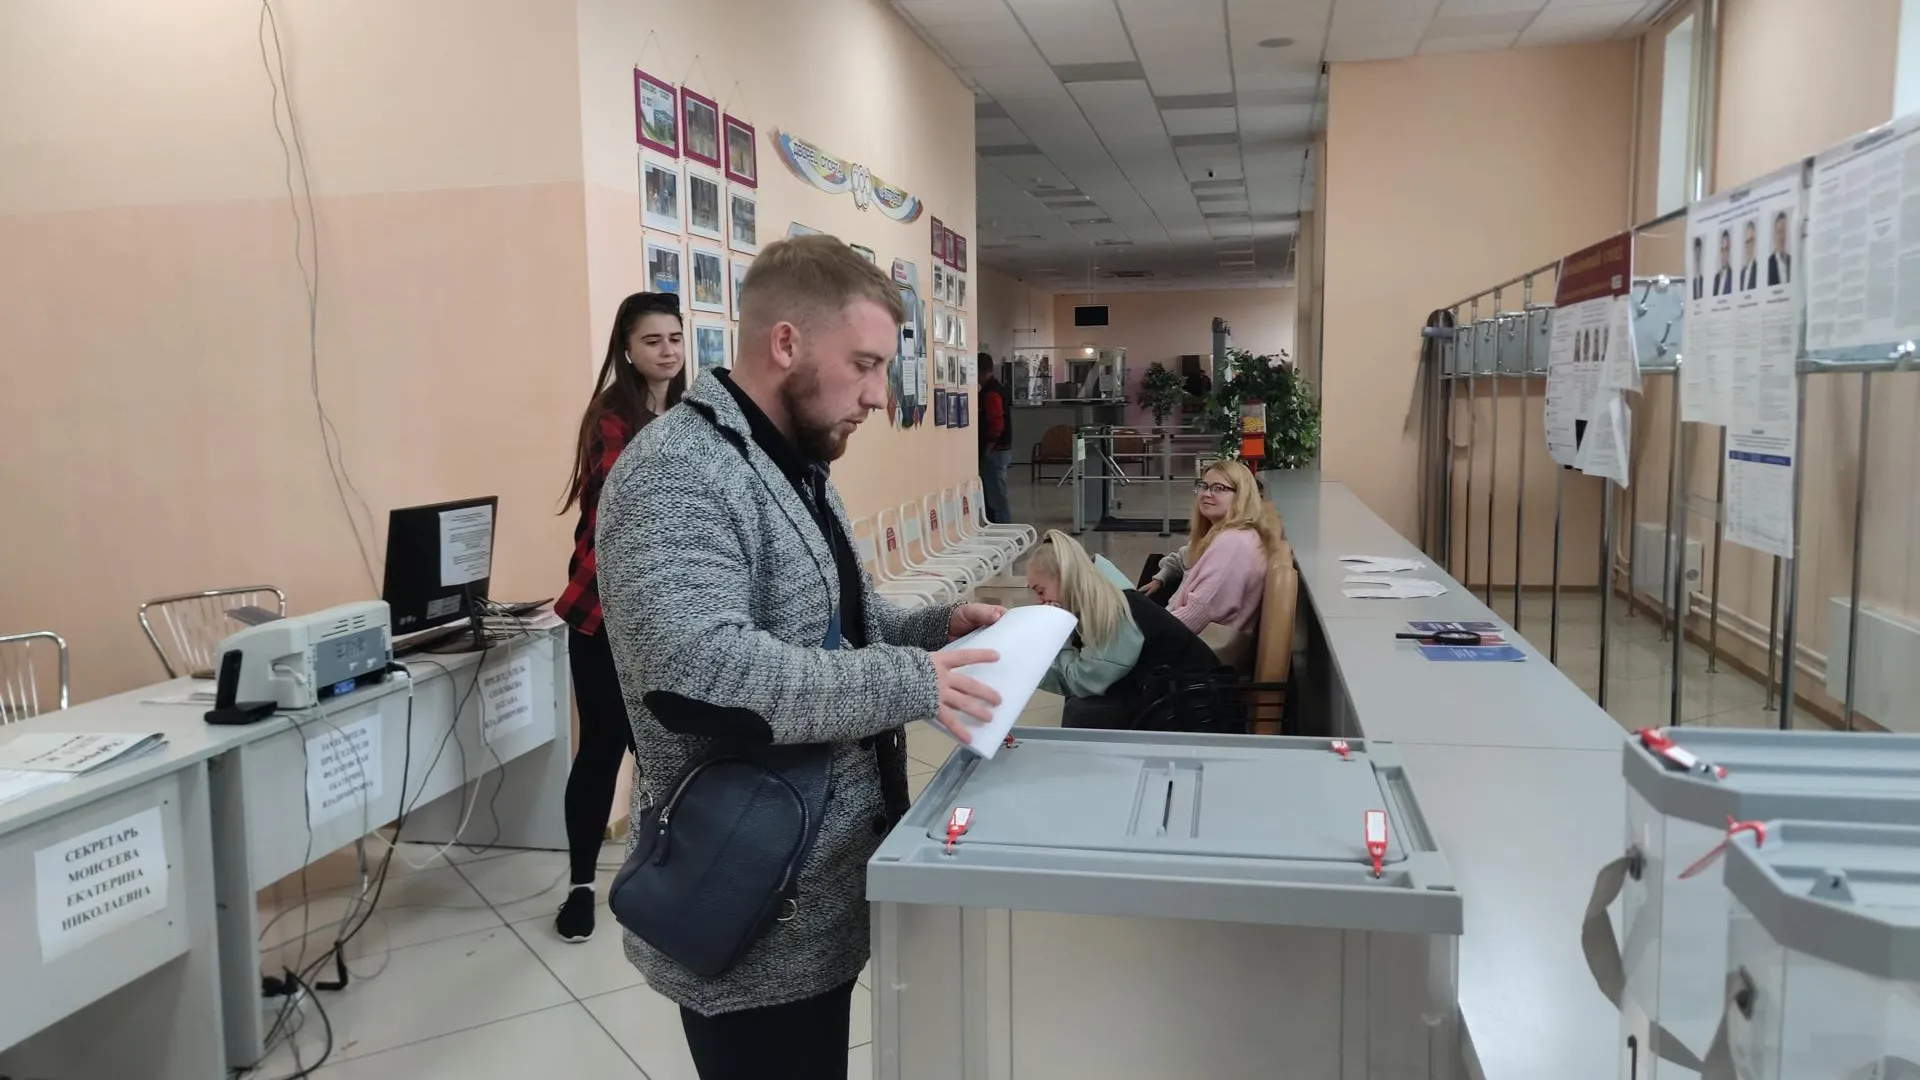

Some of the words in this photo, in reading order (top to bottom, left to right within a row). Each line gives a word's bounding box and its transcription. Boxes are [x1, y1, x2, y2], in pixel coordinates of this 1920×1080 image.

[64, 826, 139, 863] СЕКРЕТАРЬ
[68, 848, 141, 884] МОИСЕЕВА
[66, 867, 144, 907] ЕКАТЕРИНА
[61, 885, 152, 931] НИКОЛАЕВНА
